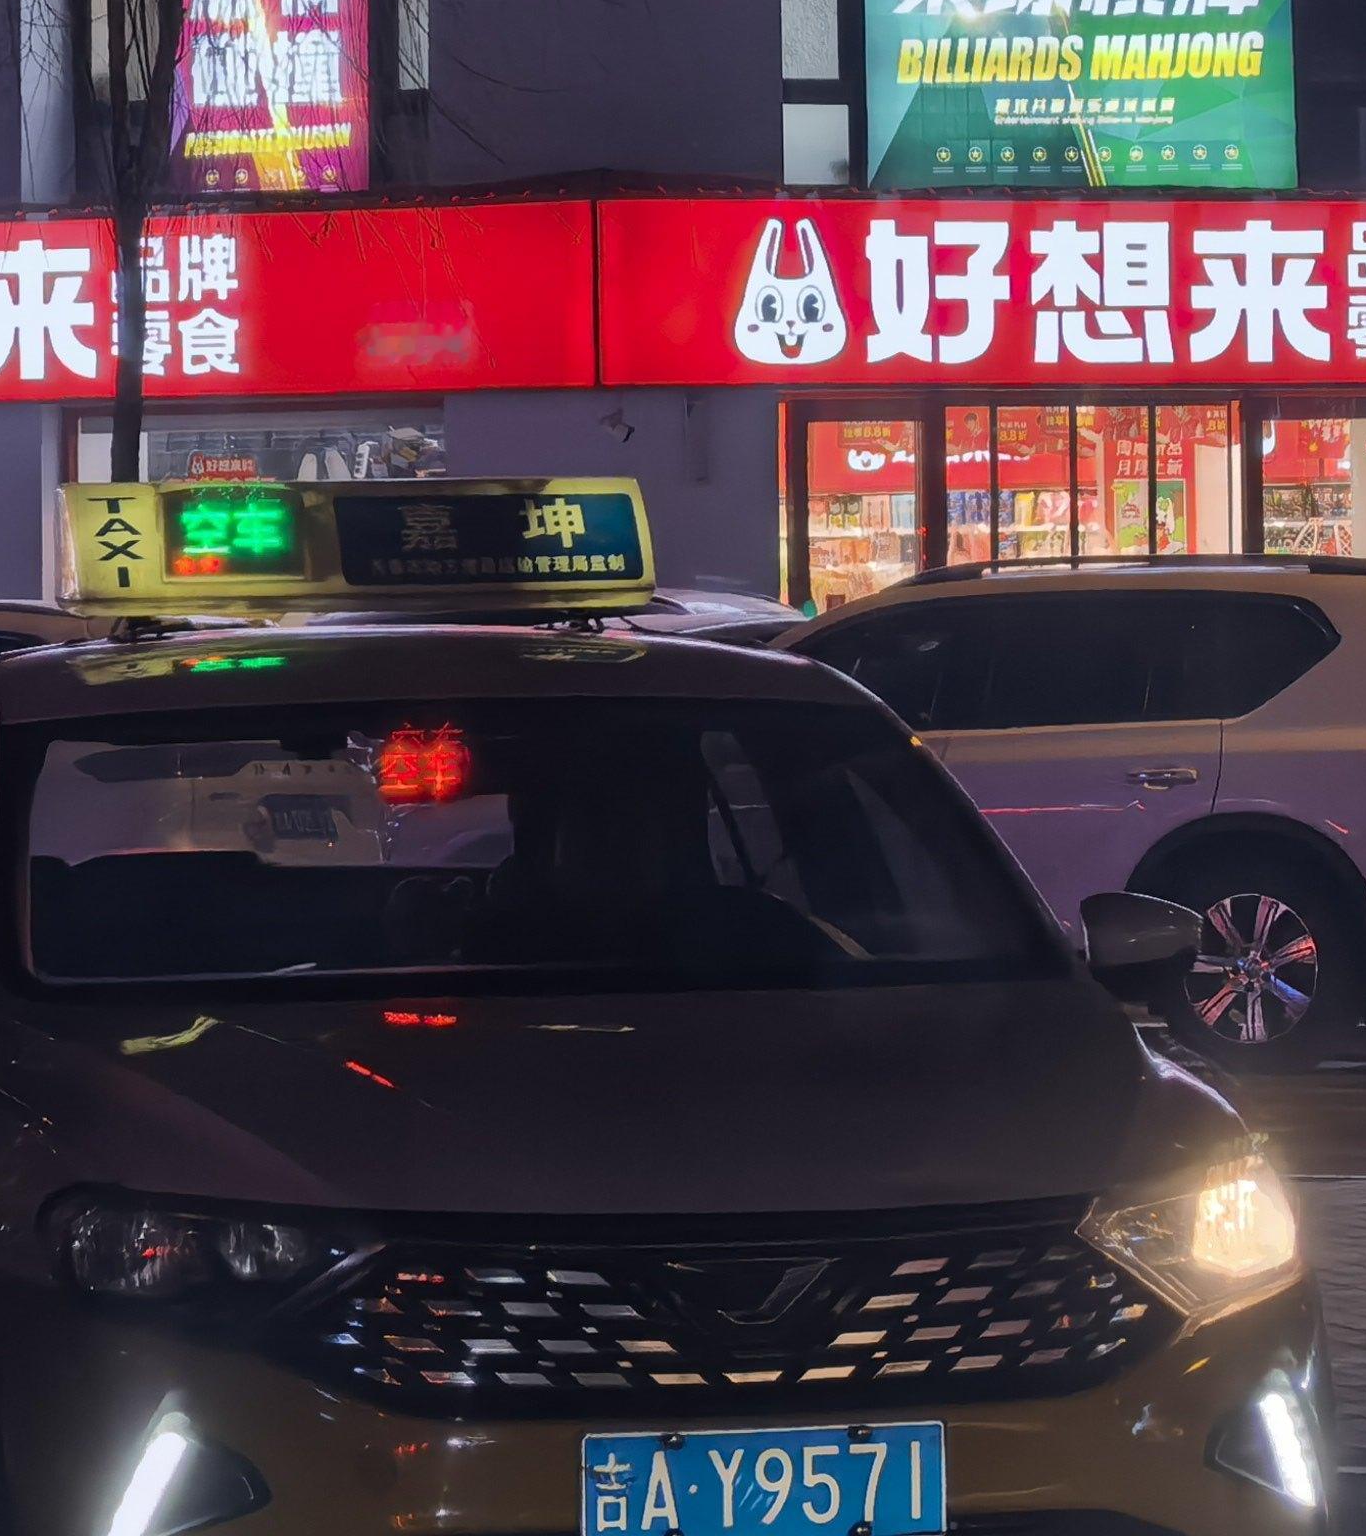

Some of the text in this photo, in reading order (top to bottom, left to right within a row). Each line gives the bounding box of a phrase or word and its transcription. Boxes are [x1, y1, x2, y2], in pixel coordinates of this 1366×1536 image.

[897, 31, 1264, 85] BILLIARDS MAHJONG
[865, 219, 1332, 365] 好想来
[87, 497, 144, 589] TAXI
[181, 503, 284, 554] 空车
